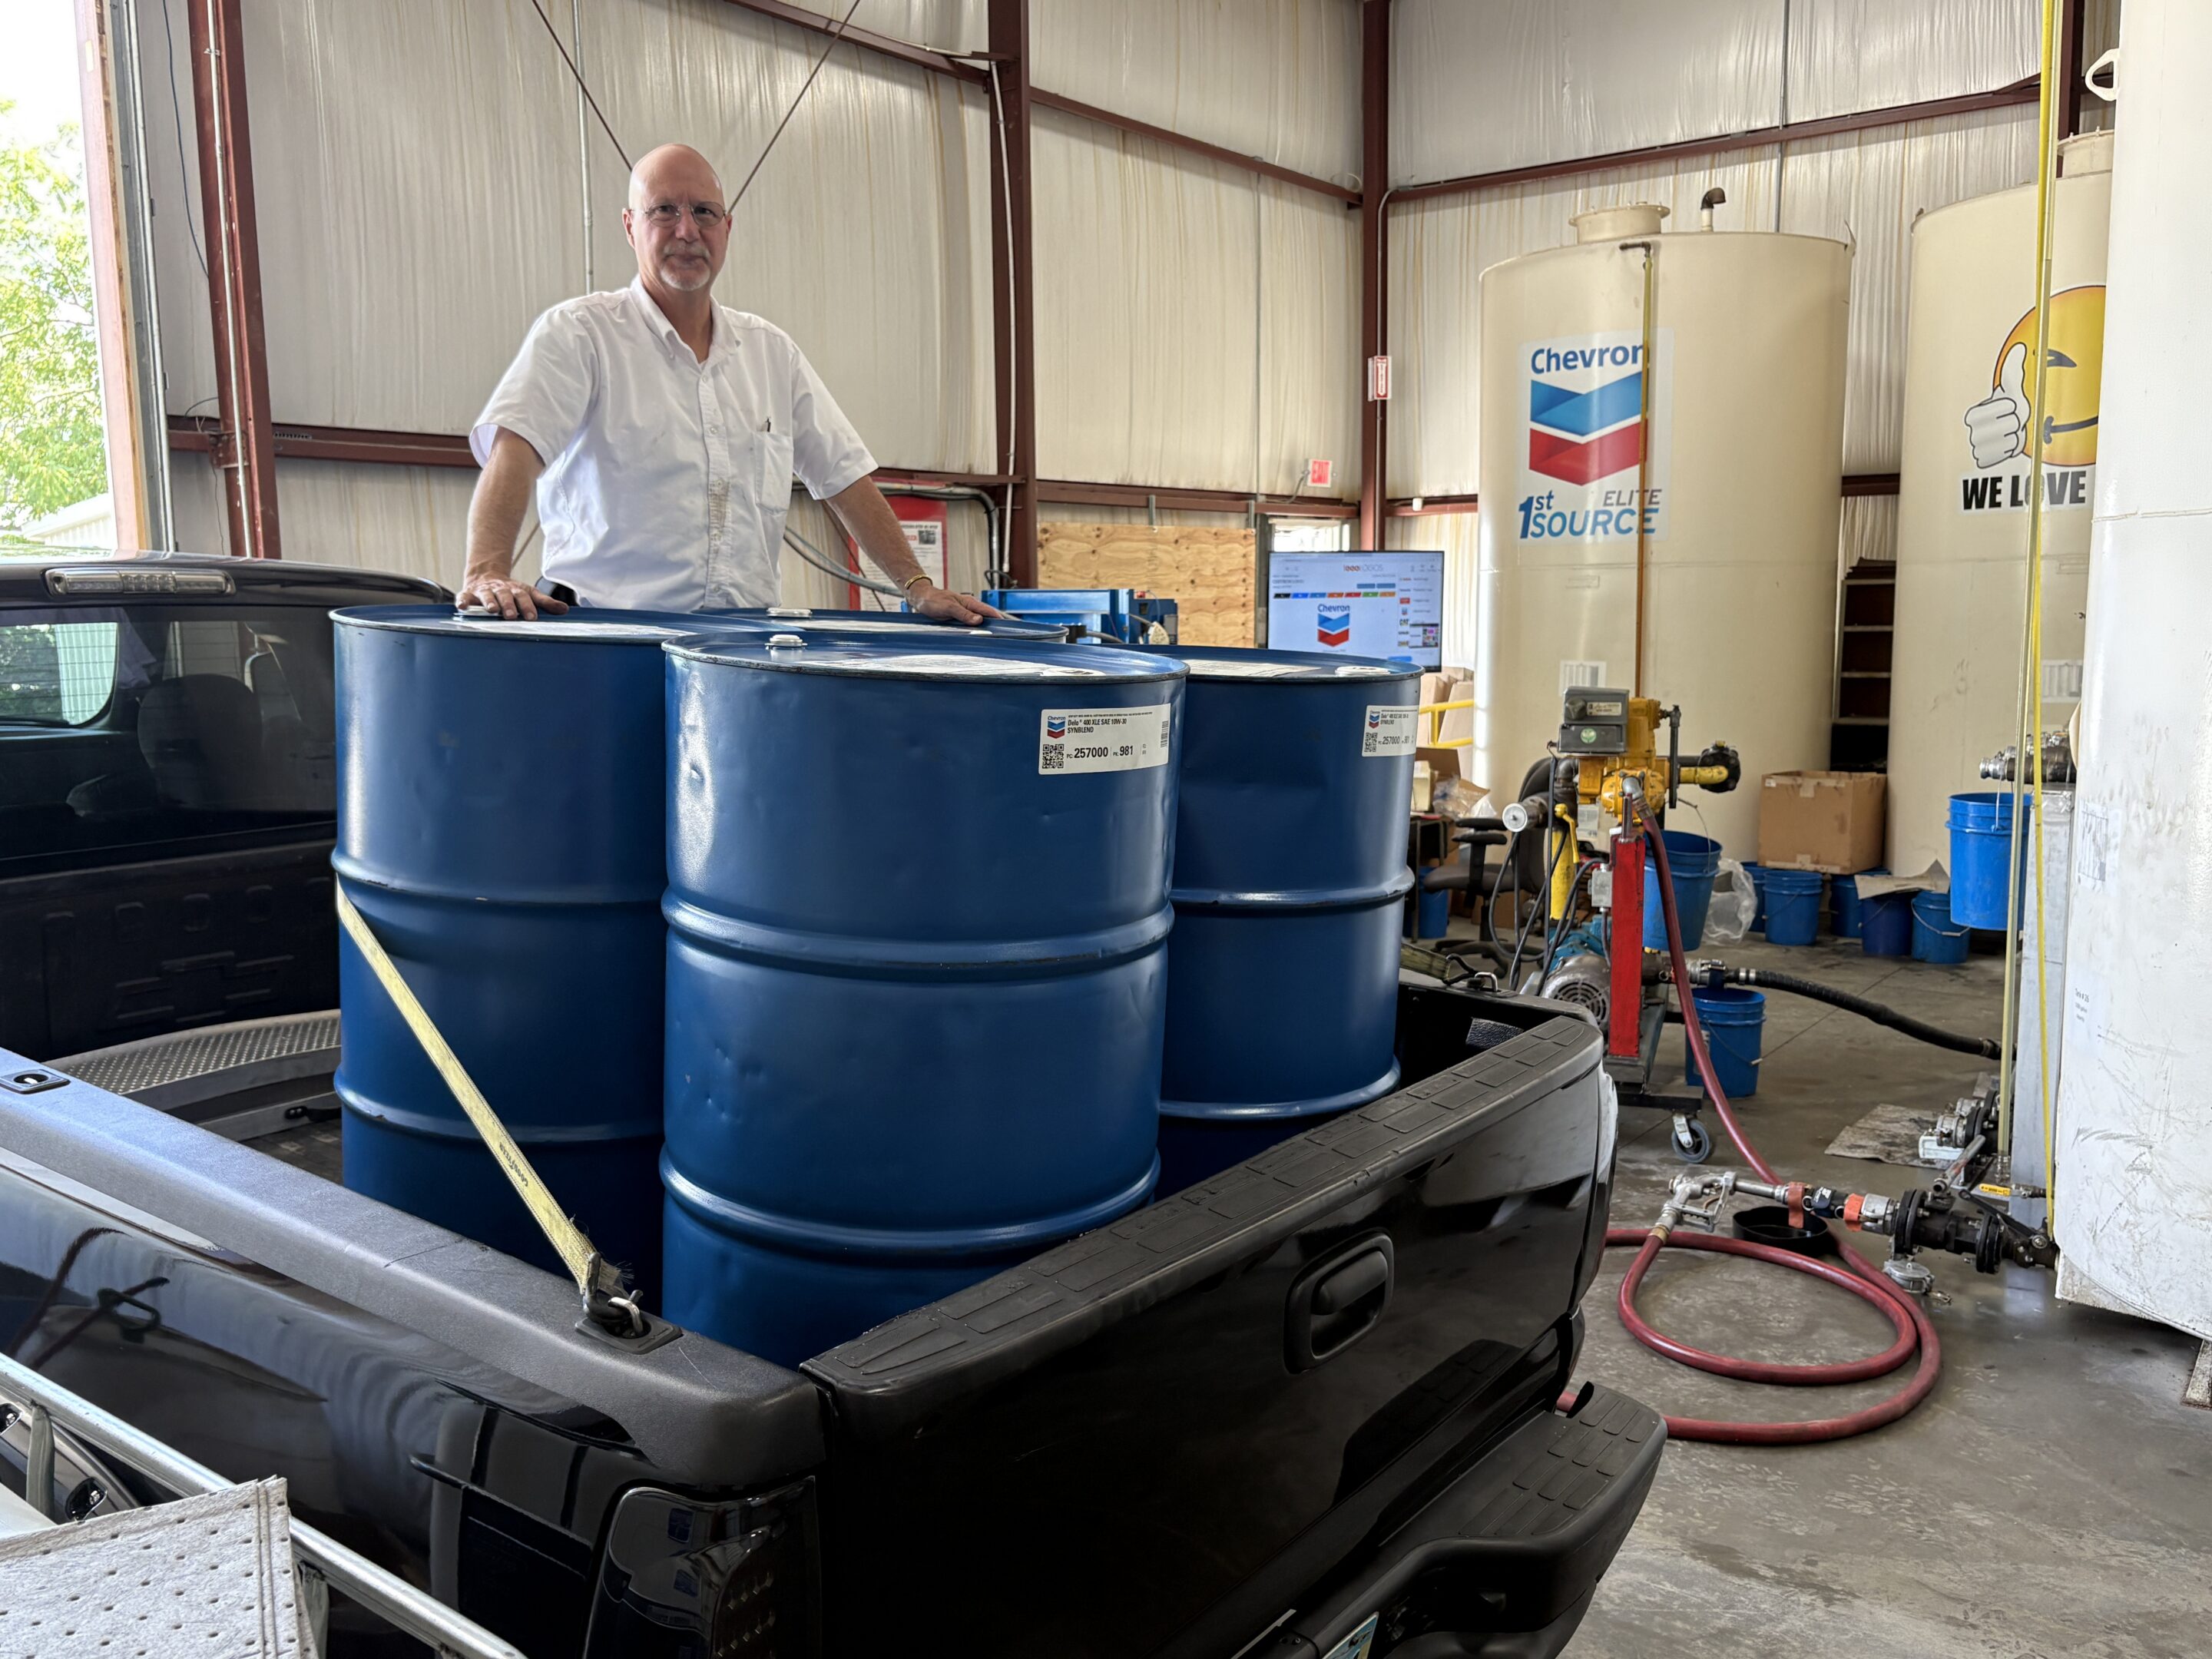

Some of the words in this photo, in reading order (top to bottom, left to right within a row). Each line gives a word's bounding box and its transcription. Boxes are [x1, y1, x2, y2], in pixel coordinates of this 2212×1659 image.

[1962, 476, 2003, 510] WE
[1518, 490, 1555, 540] 1st
[1317, 604, 1350, 613] Chevron
[1074, 747, 1109, 759] 257000
[1119, 745, 1134, 757] 981
[1382, 736, 1400, 745] 257000
[499, 1141, 528, 1187] GOODYEAR
